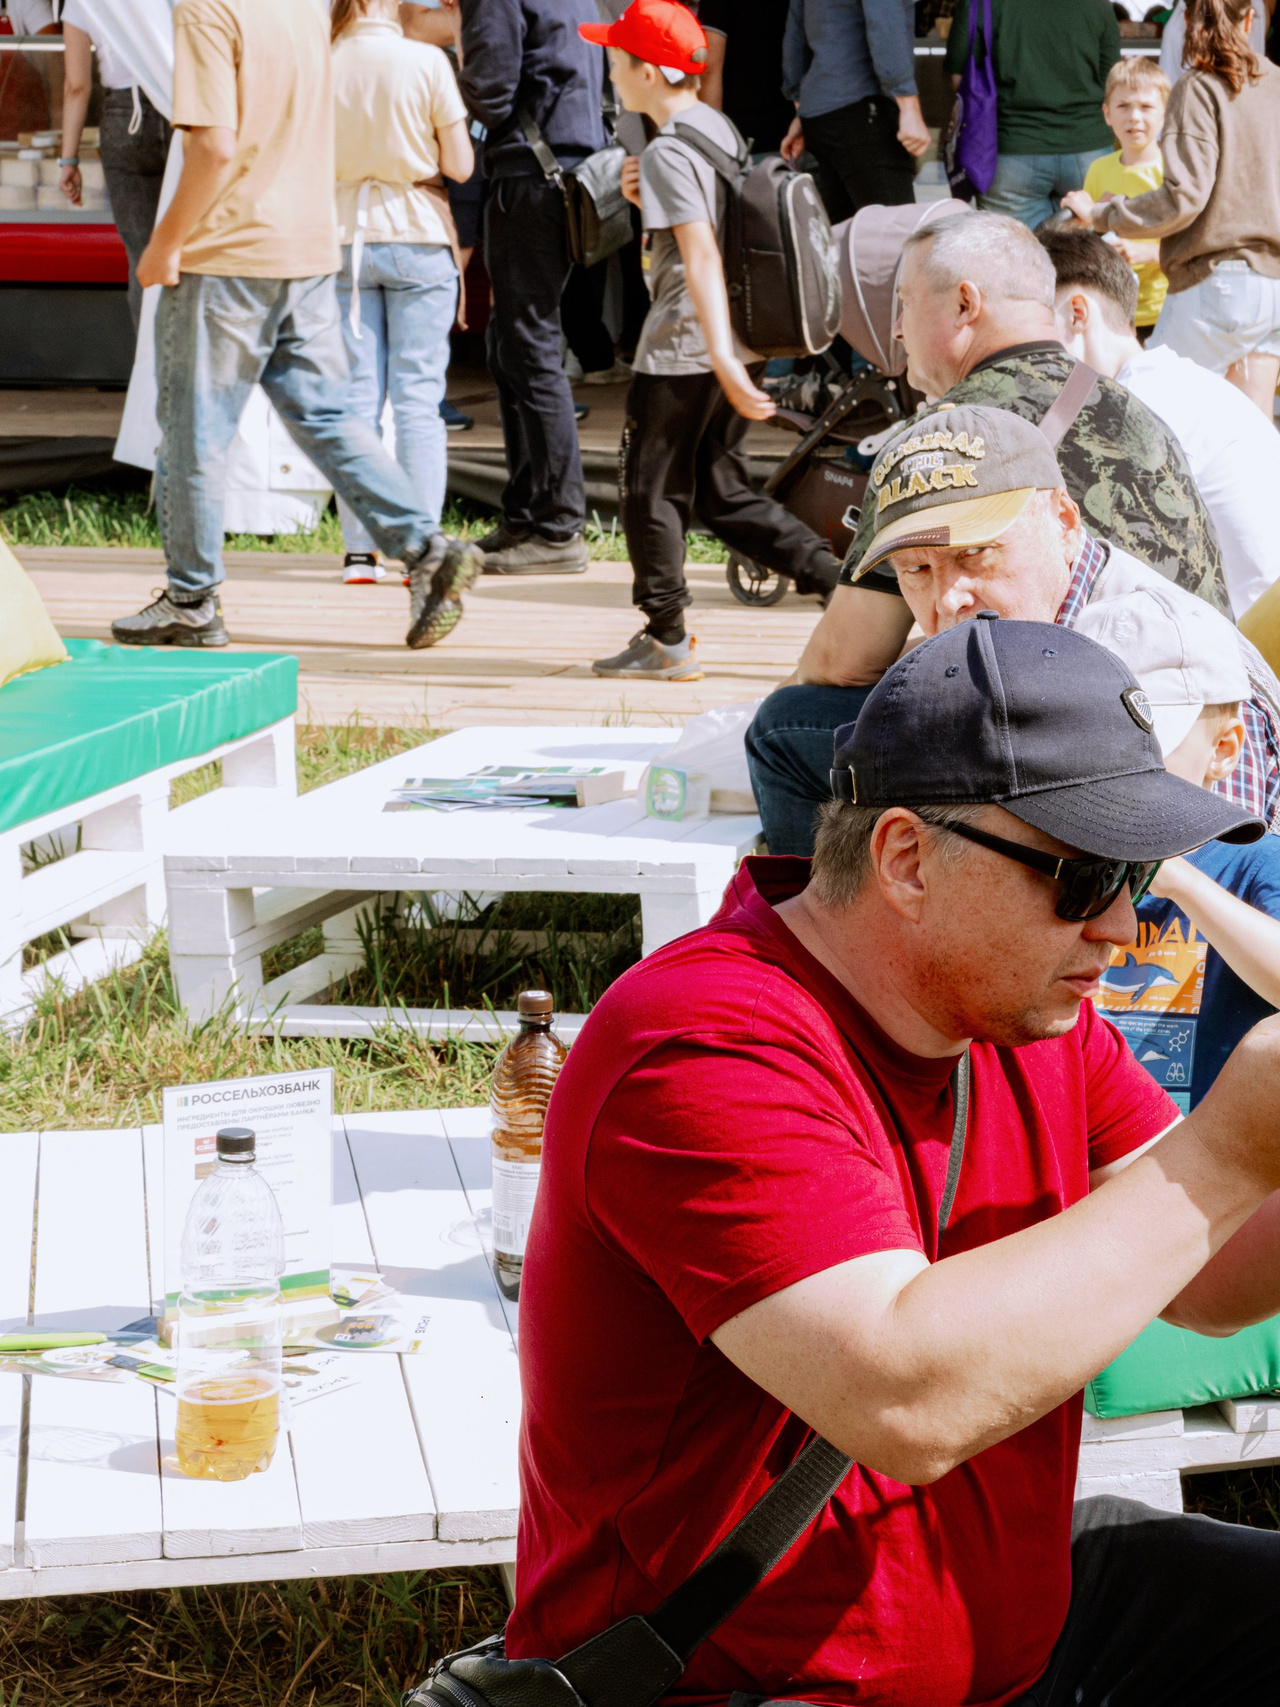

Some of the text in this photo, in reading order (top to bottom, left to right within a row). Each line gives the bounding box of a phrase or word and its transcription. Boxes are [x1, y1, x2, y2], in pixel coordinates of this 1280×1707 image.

[874, 431, 986, 486] ORIGINAL
[900, 451, 945, 477] THE
[878, 463, 979, 514] BLACK
[191, 1080, 321, 1106] РОССЕЛЬХОЗБАНК
[177, 1099, 321, 1123] ИНГРЕДИЕНТЫ ДЛЯ ОКРОШКИ ЛЮБЕЗНО
[177, 1117, 241, 1131] ПРЕДОСТАВЛЕНЫ
